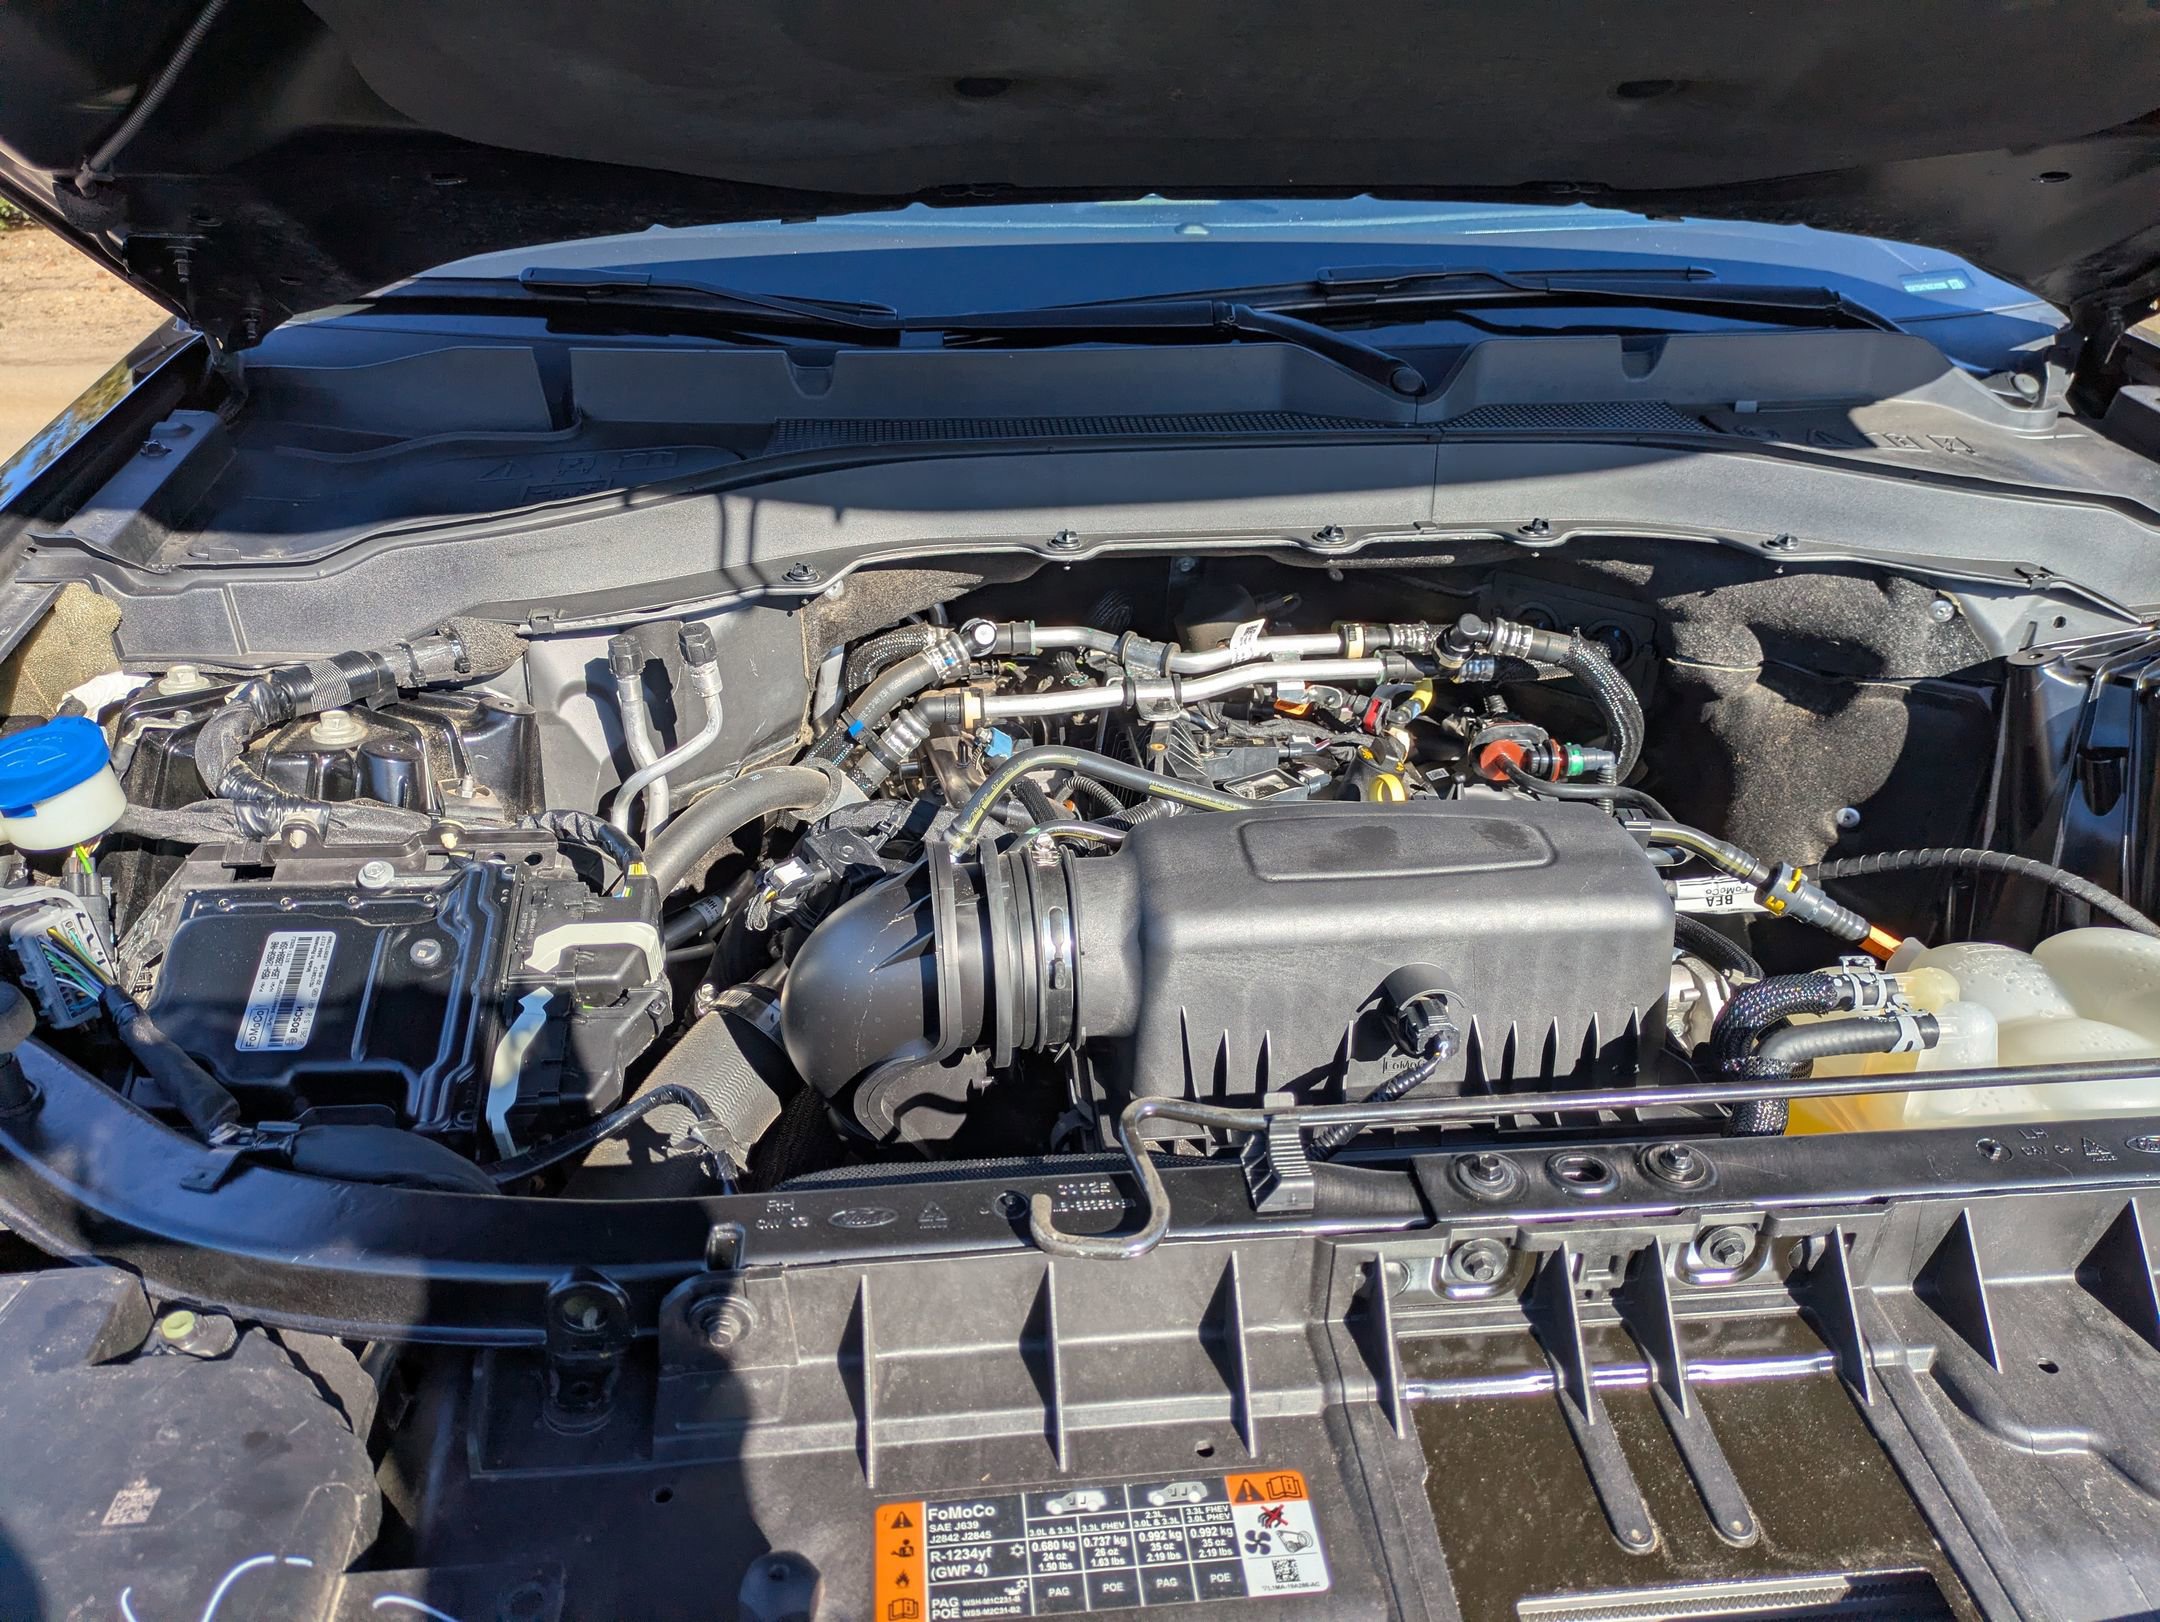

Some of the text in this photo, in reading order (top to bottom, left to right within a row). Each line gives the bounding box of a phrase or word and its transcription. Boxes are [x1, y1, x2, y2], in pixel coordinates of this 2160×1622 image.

[1706, 895, 1733, 907] BEA
[311, 936, 320, 953] Romania
[290, 1006, 304, 1033] BOSCH
[246, 1011, 264, 1047] FoMoCo
[2018, 1128, 2048, 1140] LH
[766, 1199, 794, 1214] RH
[928, 1504, 995, 1520] FoMoCo
[1186, 1505, 1228, 1515] 3.3L FHEV
[929, 1520, 979, 1533] SAE J639
[1081, 1521, 1125, 1532] 3.3L FHEV
[1133, 1519, 1152, 1527] 3.0L
[1162, 1517, 1180, 1525] 3.3L
[1029, 1528, 1047, 1536] 3.0L
[1058, 1526, 1076, 1534] 3.3L
[1138, 1529, 1183, 1542] 0.992 kg
[1190, 1525, 1234, 1538] 0.992 kg
[930, 1530, 992, 1544] J2842 J2845
[1083, 1535, 1127, 1548] 0.737 kg
[1032, 1540, 1076, 1552] 0.680 kg
[1150, 1542, 1162, 1552] 35
[1202, 1539, 1213, 1547] 35
[930, 1546, 992, 1563] R-1234yf
[1043, 1552, 1054, 1561] 24
[1094, 1548, 1106, 1557] 26
[1146, 1551, 1182, 1562] 2.19 lbs
[1198, 1548, 1233, 1558] 2.19 lbs
[1038, 1561, 1074, 1572] 1.50 lbs
[1090, 1557, 1126, 1567] 1.63 lbs
[930, 1563, 988, 1580] (GWP 4)
[1156, 1577, 1178, 1588] PAG
[1210, 1573, 1232, 1584] POE
[1048, 1587, 1070, 1597] PAG
[1102, 1582, 1125, 1593] POE
[932, 1597, 959, 1608] PAG
[932, 1608, 960, 1620] POE
